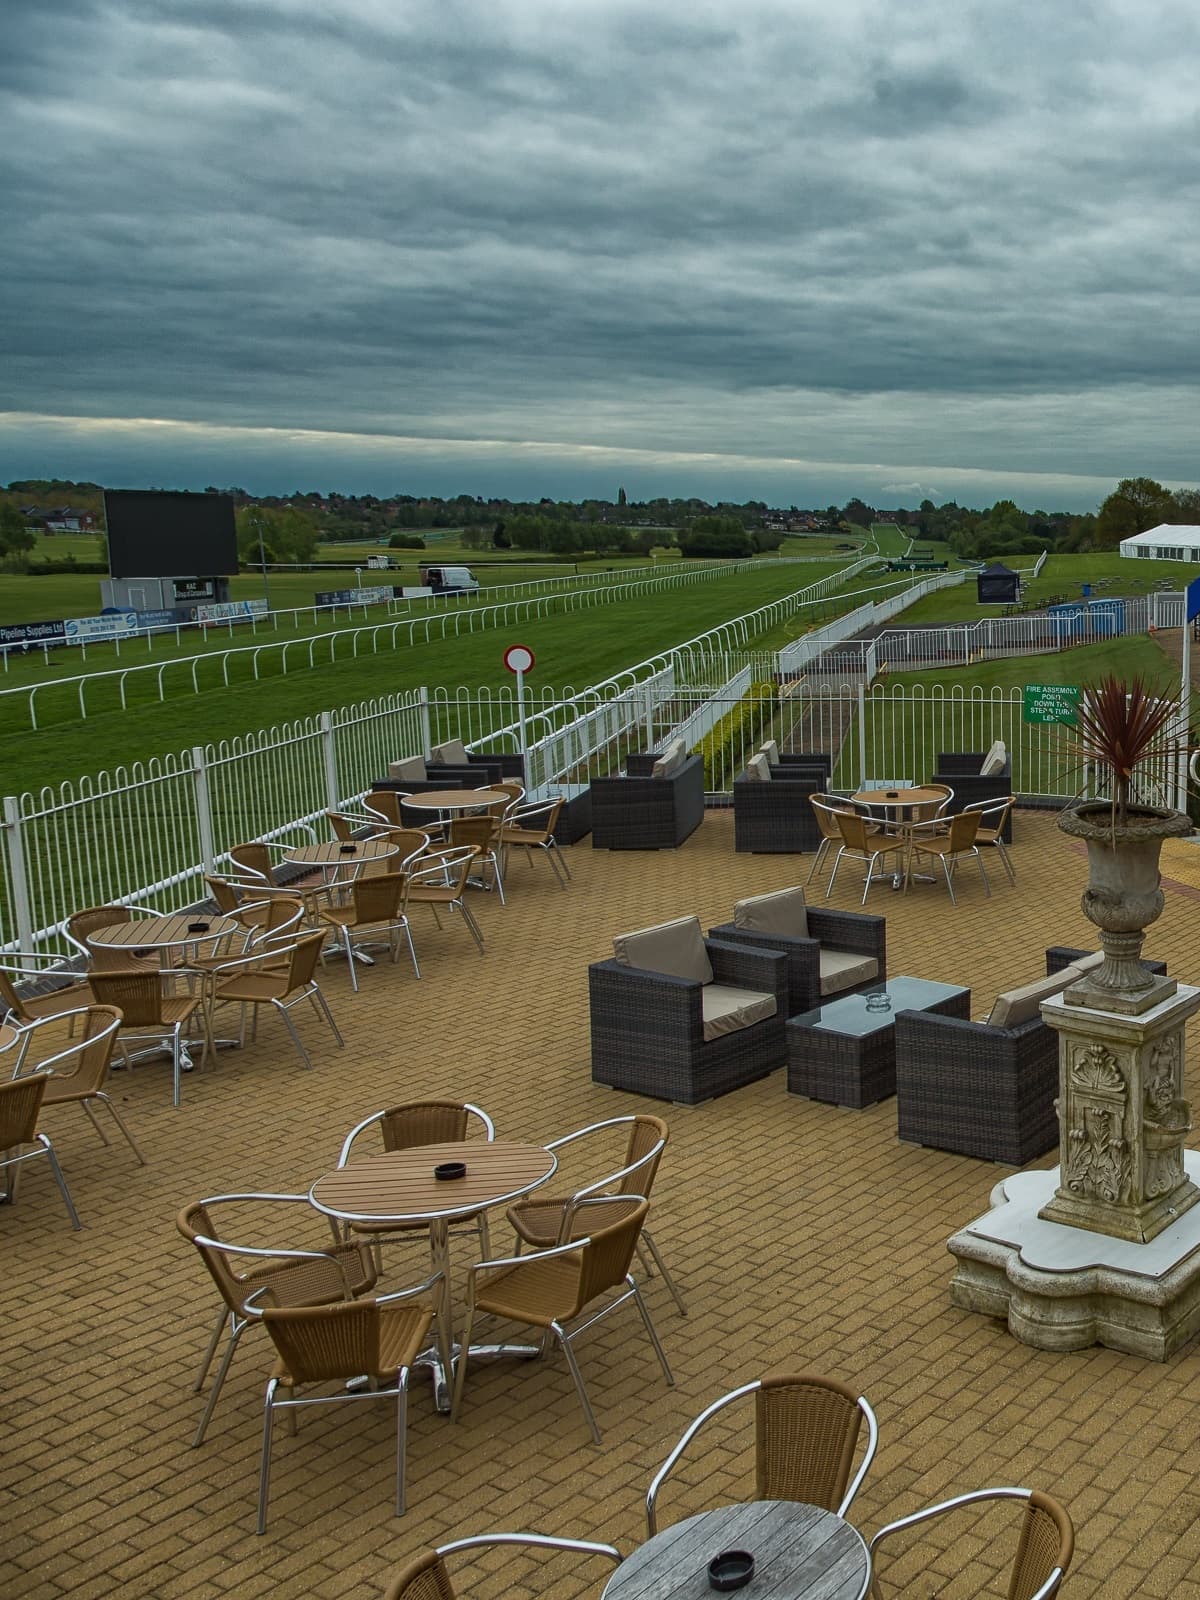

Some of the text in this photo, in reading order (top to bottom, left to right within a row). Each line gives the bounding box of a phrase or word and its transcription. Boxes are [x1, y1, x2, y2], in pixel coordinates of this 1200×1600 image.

[0, 628, 25, 641] Pipeline
[26, 624, 53, 639] Supplies
[54, 622, 63, 633] Ltd
[1042, 686, 1078, 695] ASSEMBLY
